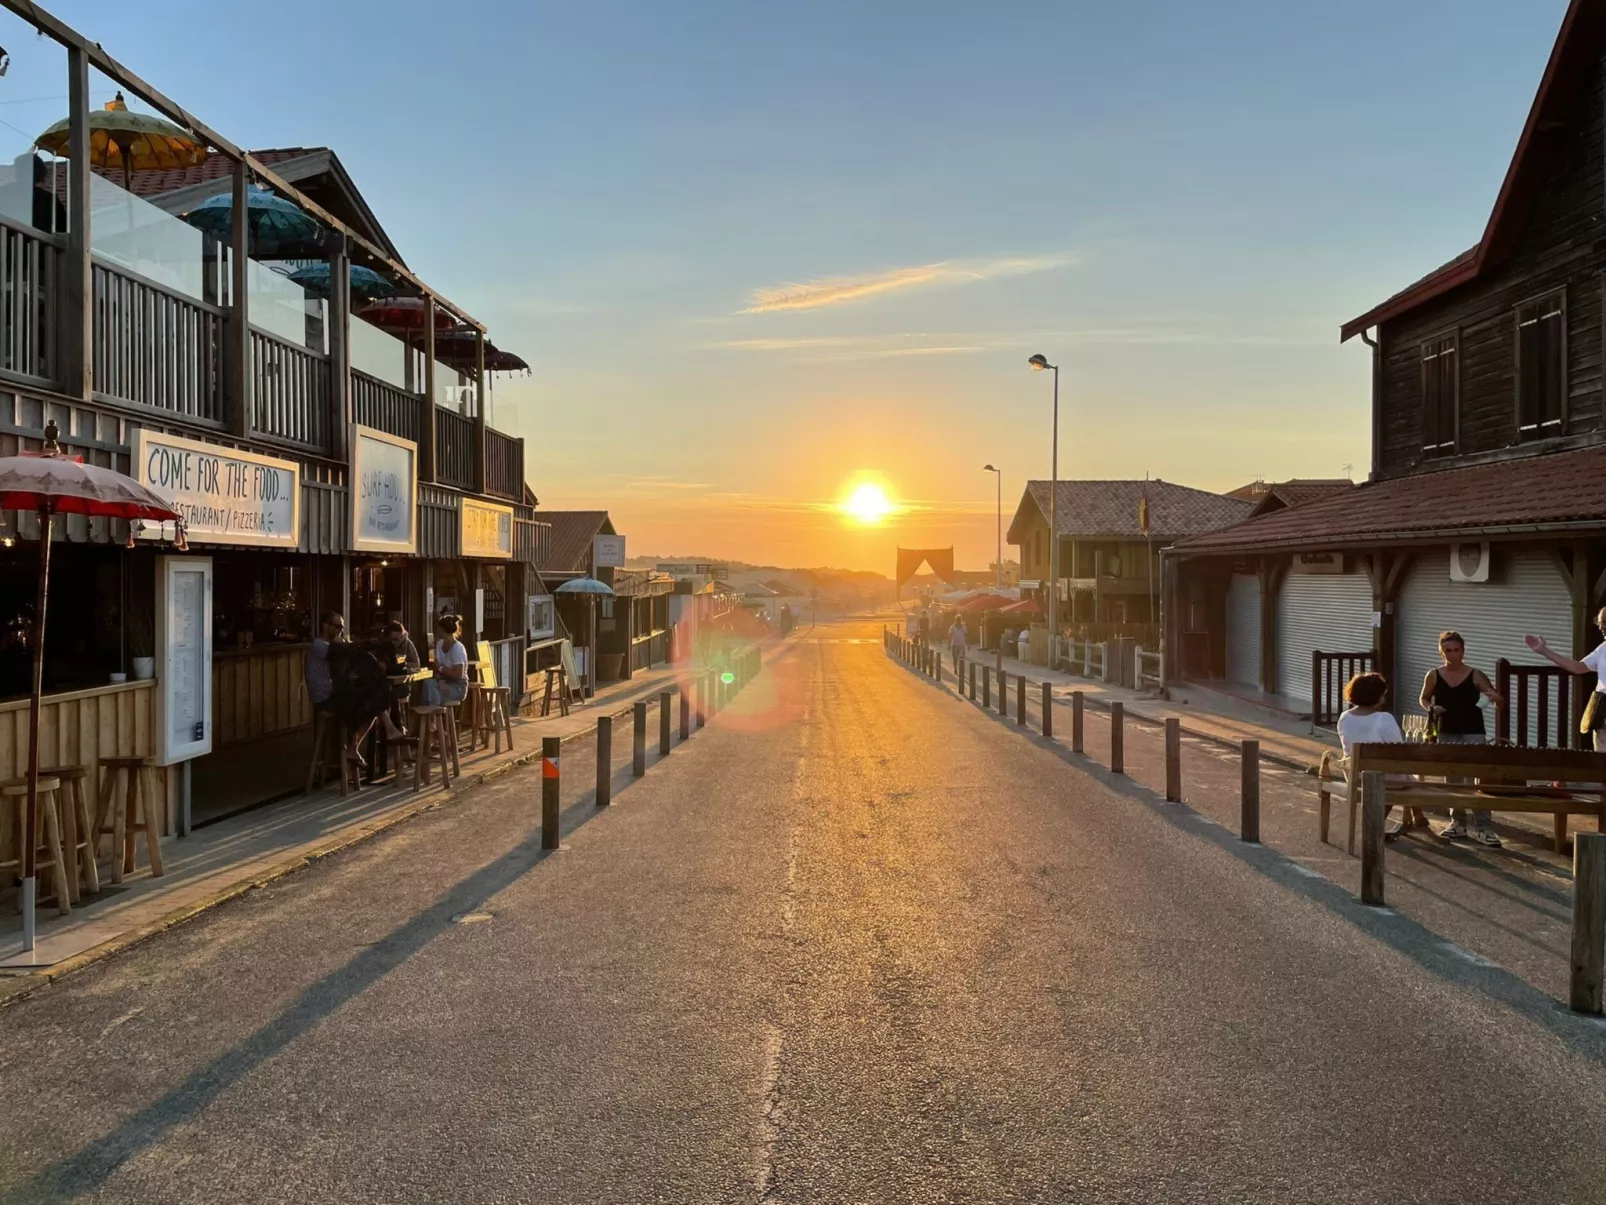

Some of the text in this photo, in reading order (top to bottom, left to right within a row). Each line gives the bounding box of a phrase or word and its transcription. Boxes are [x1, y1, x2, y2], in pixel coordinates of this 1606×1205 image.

[148, 448, 290, 502] COME FOR THE FOOD...
[384, 473, 406, 505] HOU
